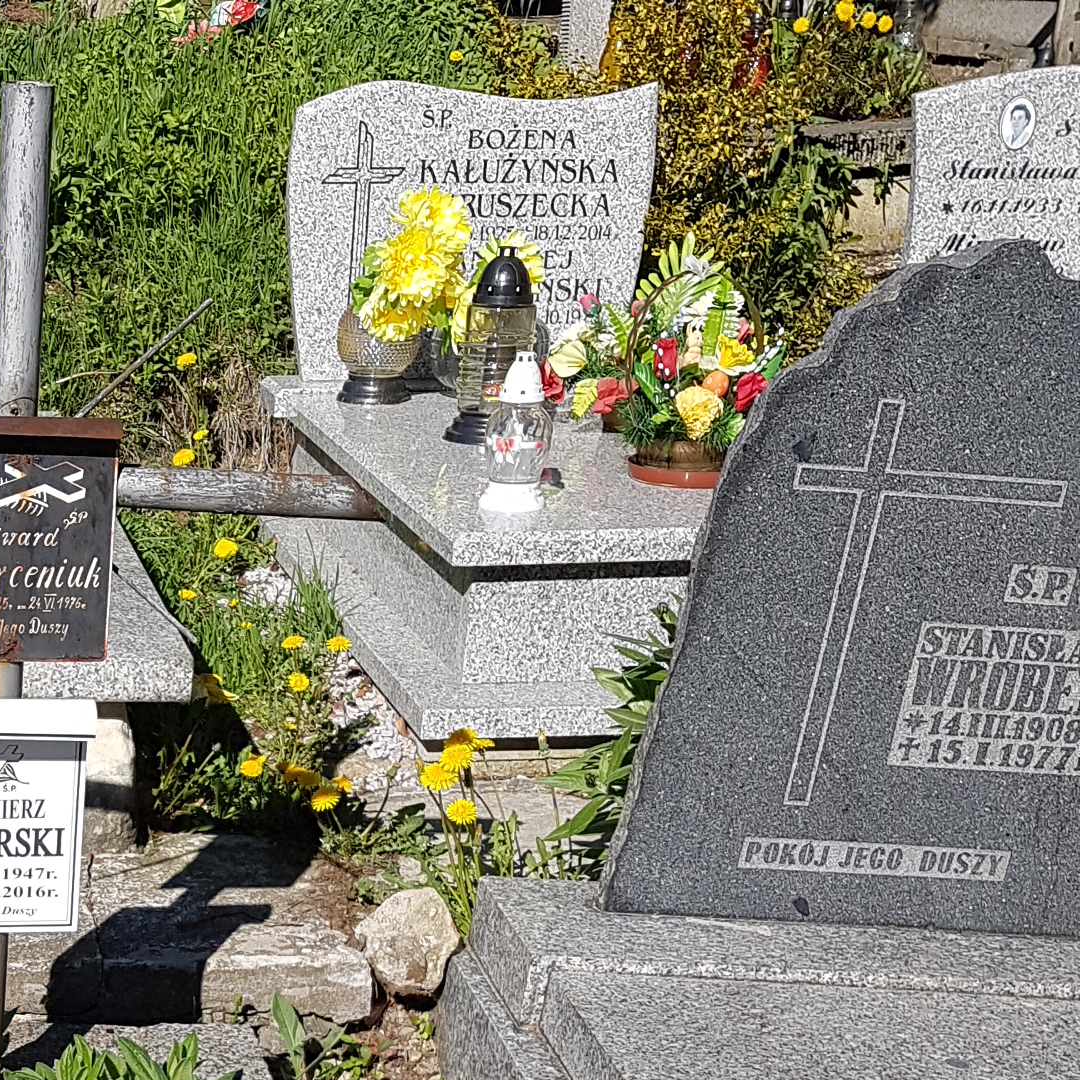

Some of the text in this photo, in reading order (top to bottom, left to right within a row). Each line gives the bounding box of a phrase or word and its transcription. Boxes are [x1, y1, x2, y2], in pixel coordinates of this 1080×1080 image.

[469, 124, 577, 150] BOŻENA
[420, 152, 619, 184] KAŁUŻYŃSKA
[451, 193, 611, 218] RUSZECKA
[28, 616, 70, 641] Duszy
[919, 850, 1005, 876] DUSZY
[1, 905, 38, 917] Duszy
